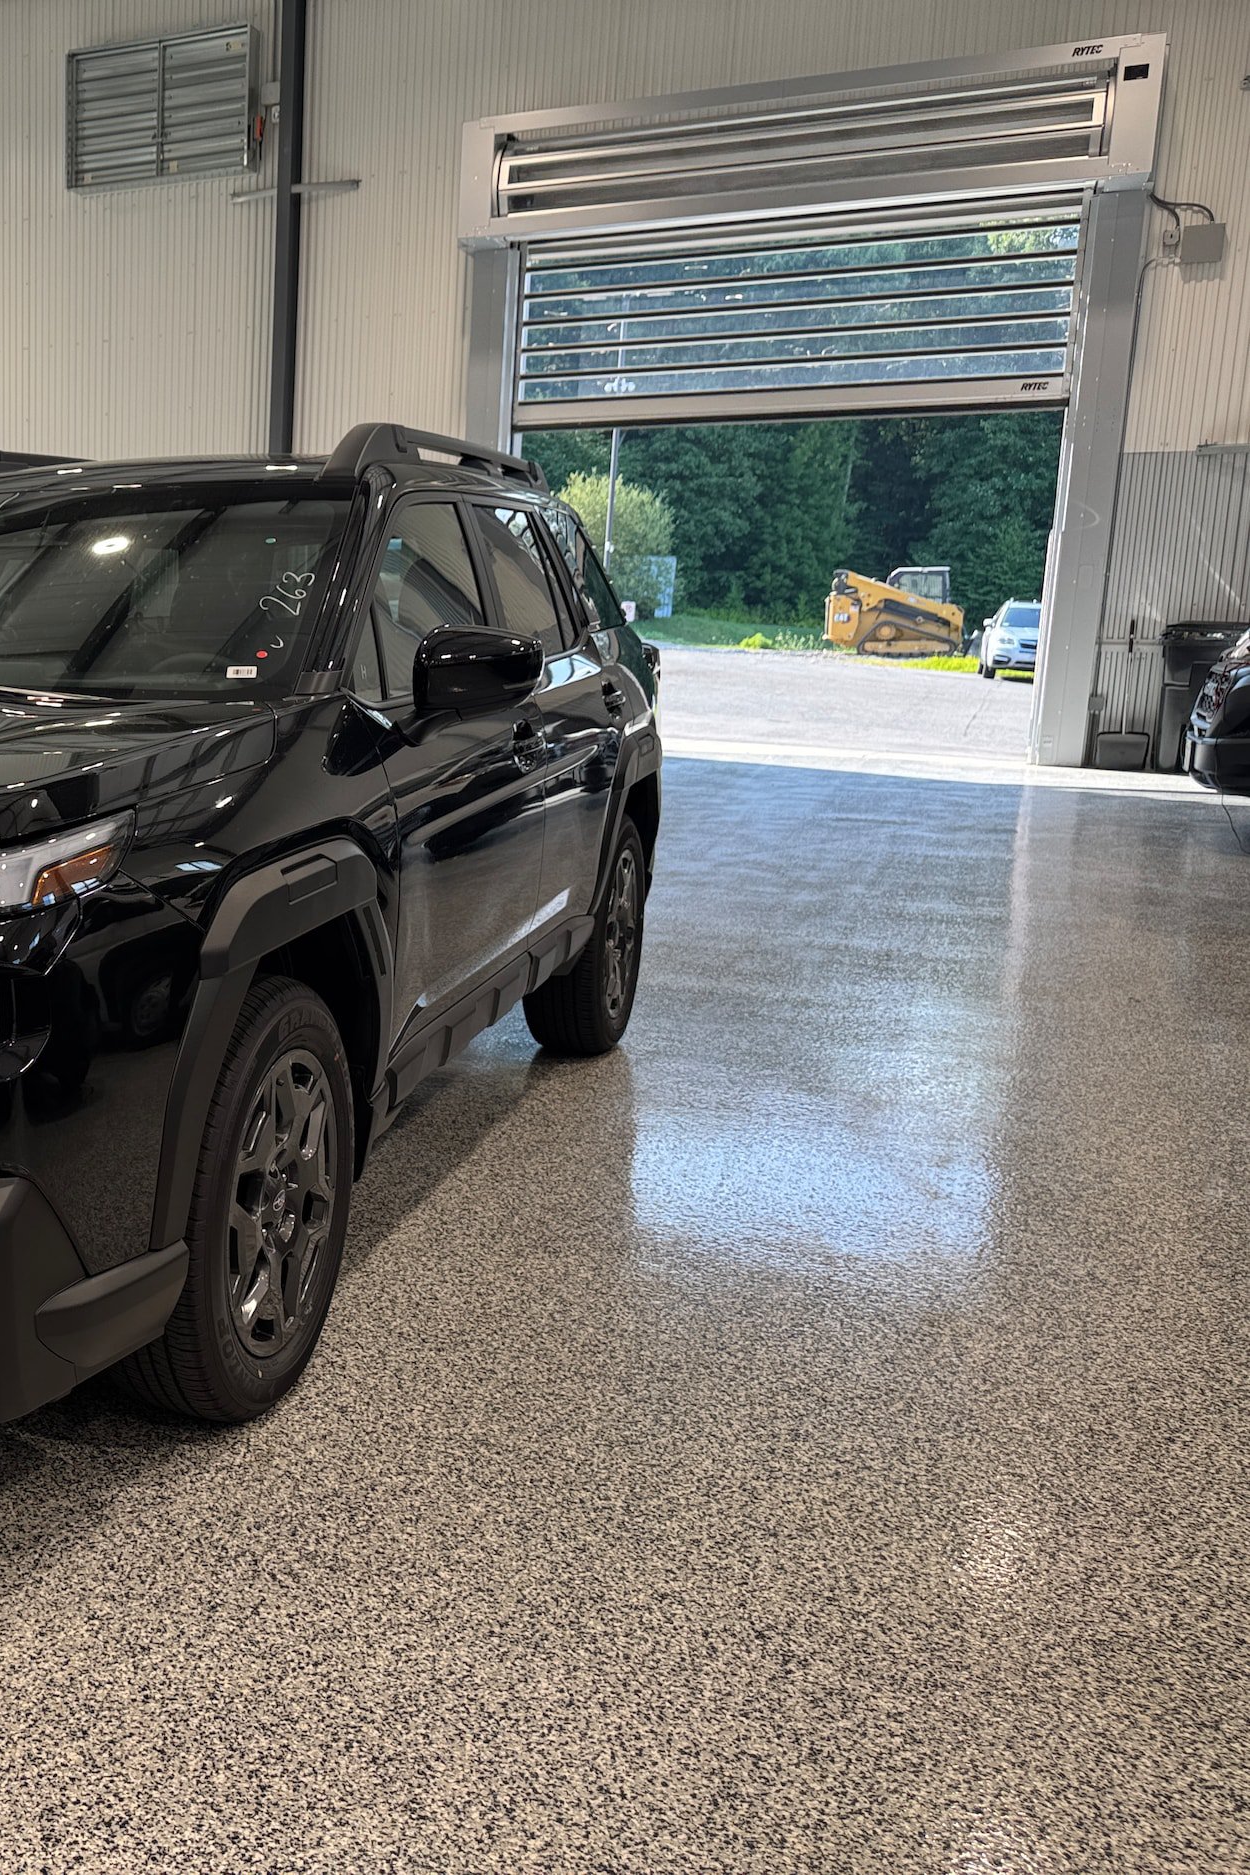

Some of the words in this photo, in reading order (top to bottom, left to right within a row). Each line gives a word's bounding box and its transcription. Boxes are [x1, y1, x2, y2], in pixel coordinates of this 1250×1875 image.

[1072, 44, 1104, 57] RYTEC
[1021, 381, 1049, 391] RYTEC
[259, 571, 316, 616] 263
